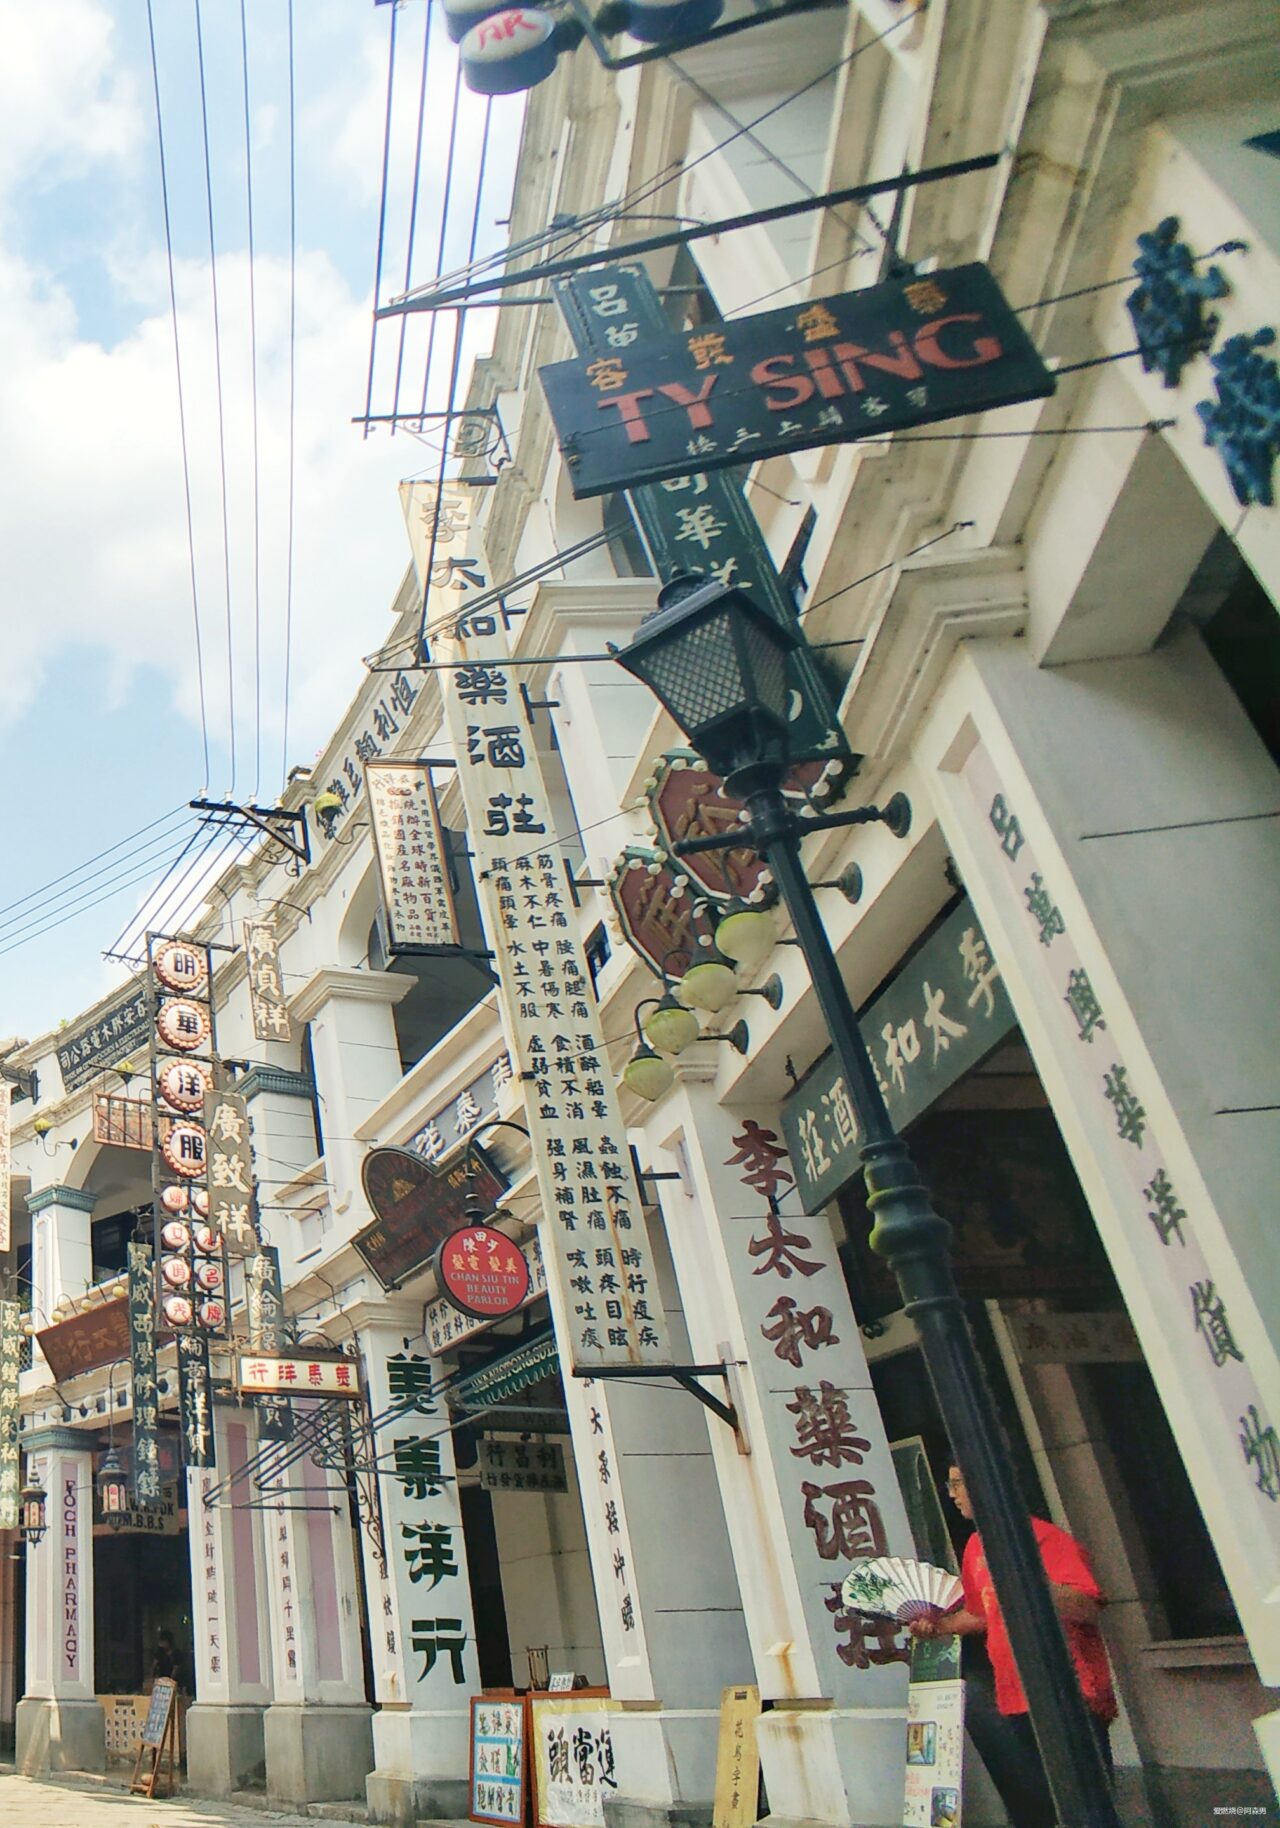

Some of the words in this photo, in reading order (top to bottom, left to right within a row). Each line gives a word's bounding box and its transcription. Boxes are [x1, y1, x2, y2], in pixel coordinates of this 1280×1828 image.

[598, 374, 718, 444] TY
[751, 313, 1003, 411] SING
[450, 1272, 480, 1284] CHAN
[483, 1273, 500, 1285] SIU
[502, 1274, 520, 1286] TIN
[467, 1284, 508, 1295] BEAUTY
[467, 1295, 510, 1306] PARLOR
[249, 1363, 351, 1388] 美泰洋行
[63, 1480, 78, 1538] FOCH
[386, 1352, 467, 1684] 美泰洋行
[65, 1548, 81, 1668] PHARMACY
